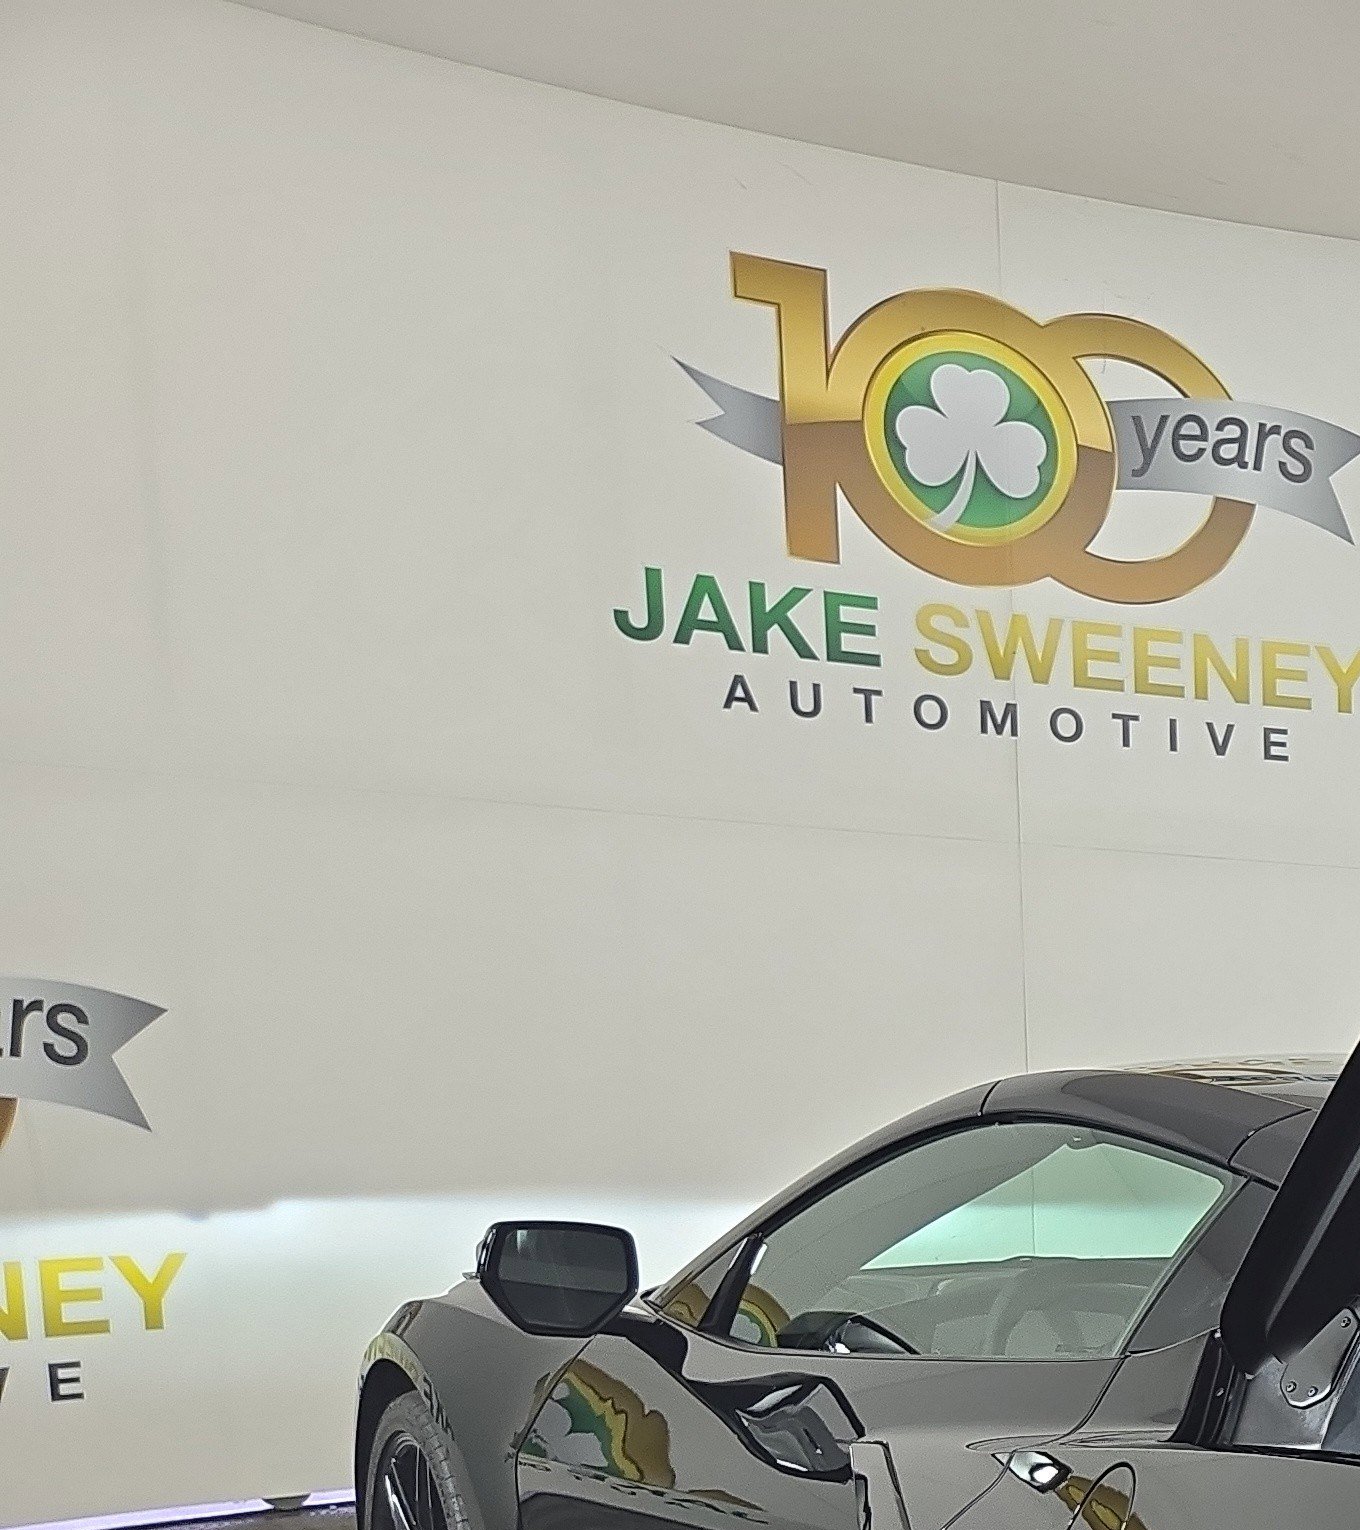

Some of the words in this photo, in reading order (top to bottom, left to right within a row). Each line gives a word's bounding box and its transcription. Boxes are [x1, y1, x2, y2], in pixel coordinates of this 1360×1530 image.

[1130, 408, 1317, 486] years
[612, 566, 882, 667] JAKE
[723, 673, 1290, 762] AUTOMOTIVE
[0, 998, 90, 1067] rs
